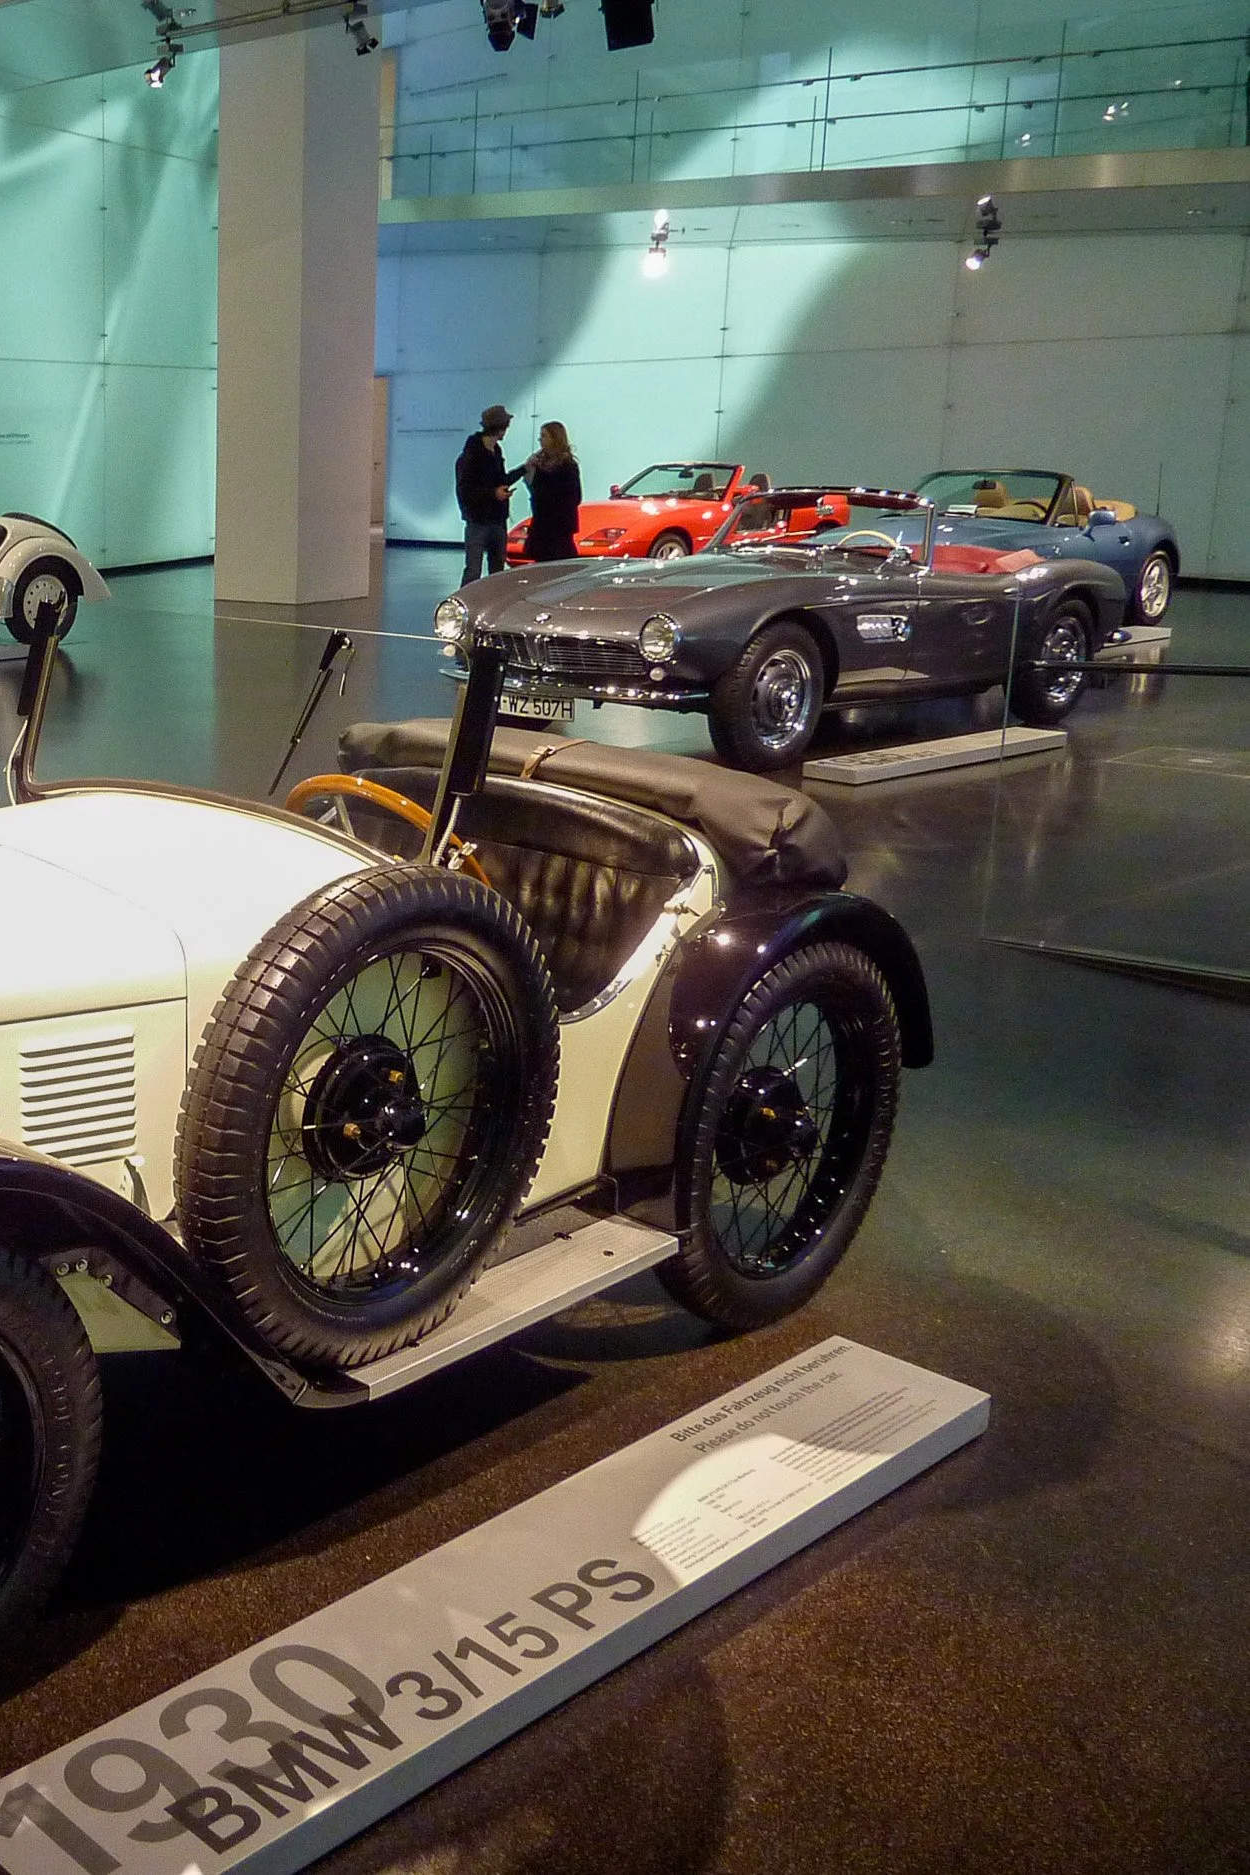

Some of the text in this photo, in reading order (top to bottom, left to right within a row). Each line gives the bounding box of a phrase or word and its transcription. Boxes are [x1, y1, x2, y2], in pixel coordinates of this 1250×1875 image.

[533, 698, 573, 719] 507H
[670, 1423, 706, 1442] Bitte
[703, 1412, 729, 1426] das
[720, 1383, 780, 1415] Fahrzeug
[774, 1366, 806, 1388] nicht
[693, 1429, 741, 1453] Please
[736, 1420, 756, 1432] do
[753, 1405, 771, 1422] not
[769, 1391, 807, 1415] touch
[799, 1381, 824, 1396] the
[164, 1558, 656, 1855] BMW 3/15 PS
